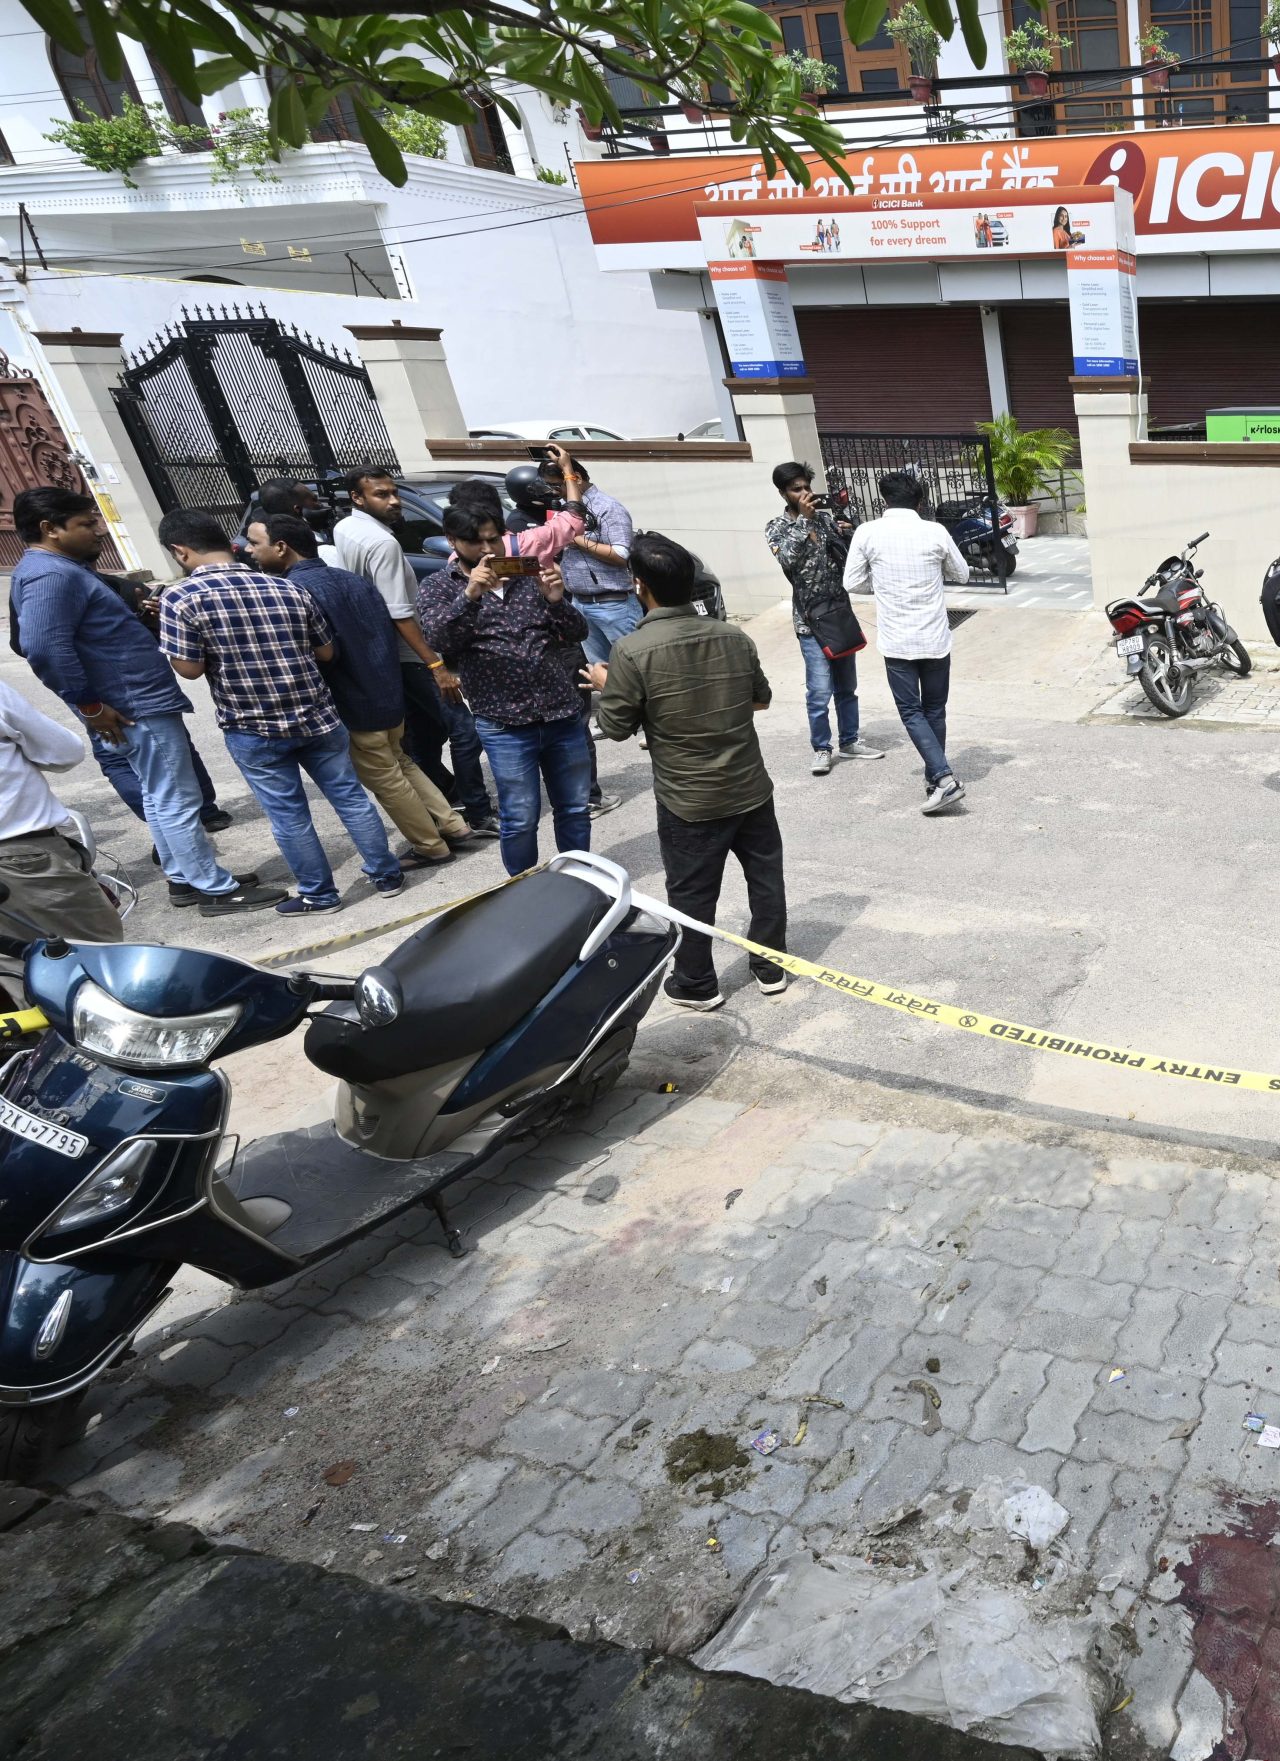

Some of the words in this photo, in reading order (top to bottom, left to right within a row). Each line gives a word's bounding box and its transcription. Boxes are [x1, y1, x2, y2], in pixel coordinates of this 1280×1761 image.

[879, 200, 900, 209] ICICI
[901, 200, 923, 208] Bank
[871, 220, 898, 231] 100%
[900, 219, 941, 231] Support
[870, 237, 884, 246] for
[887, 236, 912, 247] every
[915, 234, 947, 245] dream
[883, 991, 941, 1016] प्रवेश
[989, 1022, 1147, 1069] PROHIBITED
[69, 1053, 98, 1071] TVS
[1151, 1059, 1241, 1085] ENTRY
[131, 1084, 157, 1096] GRANDE
